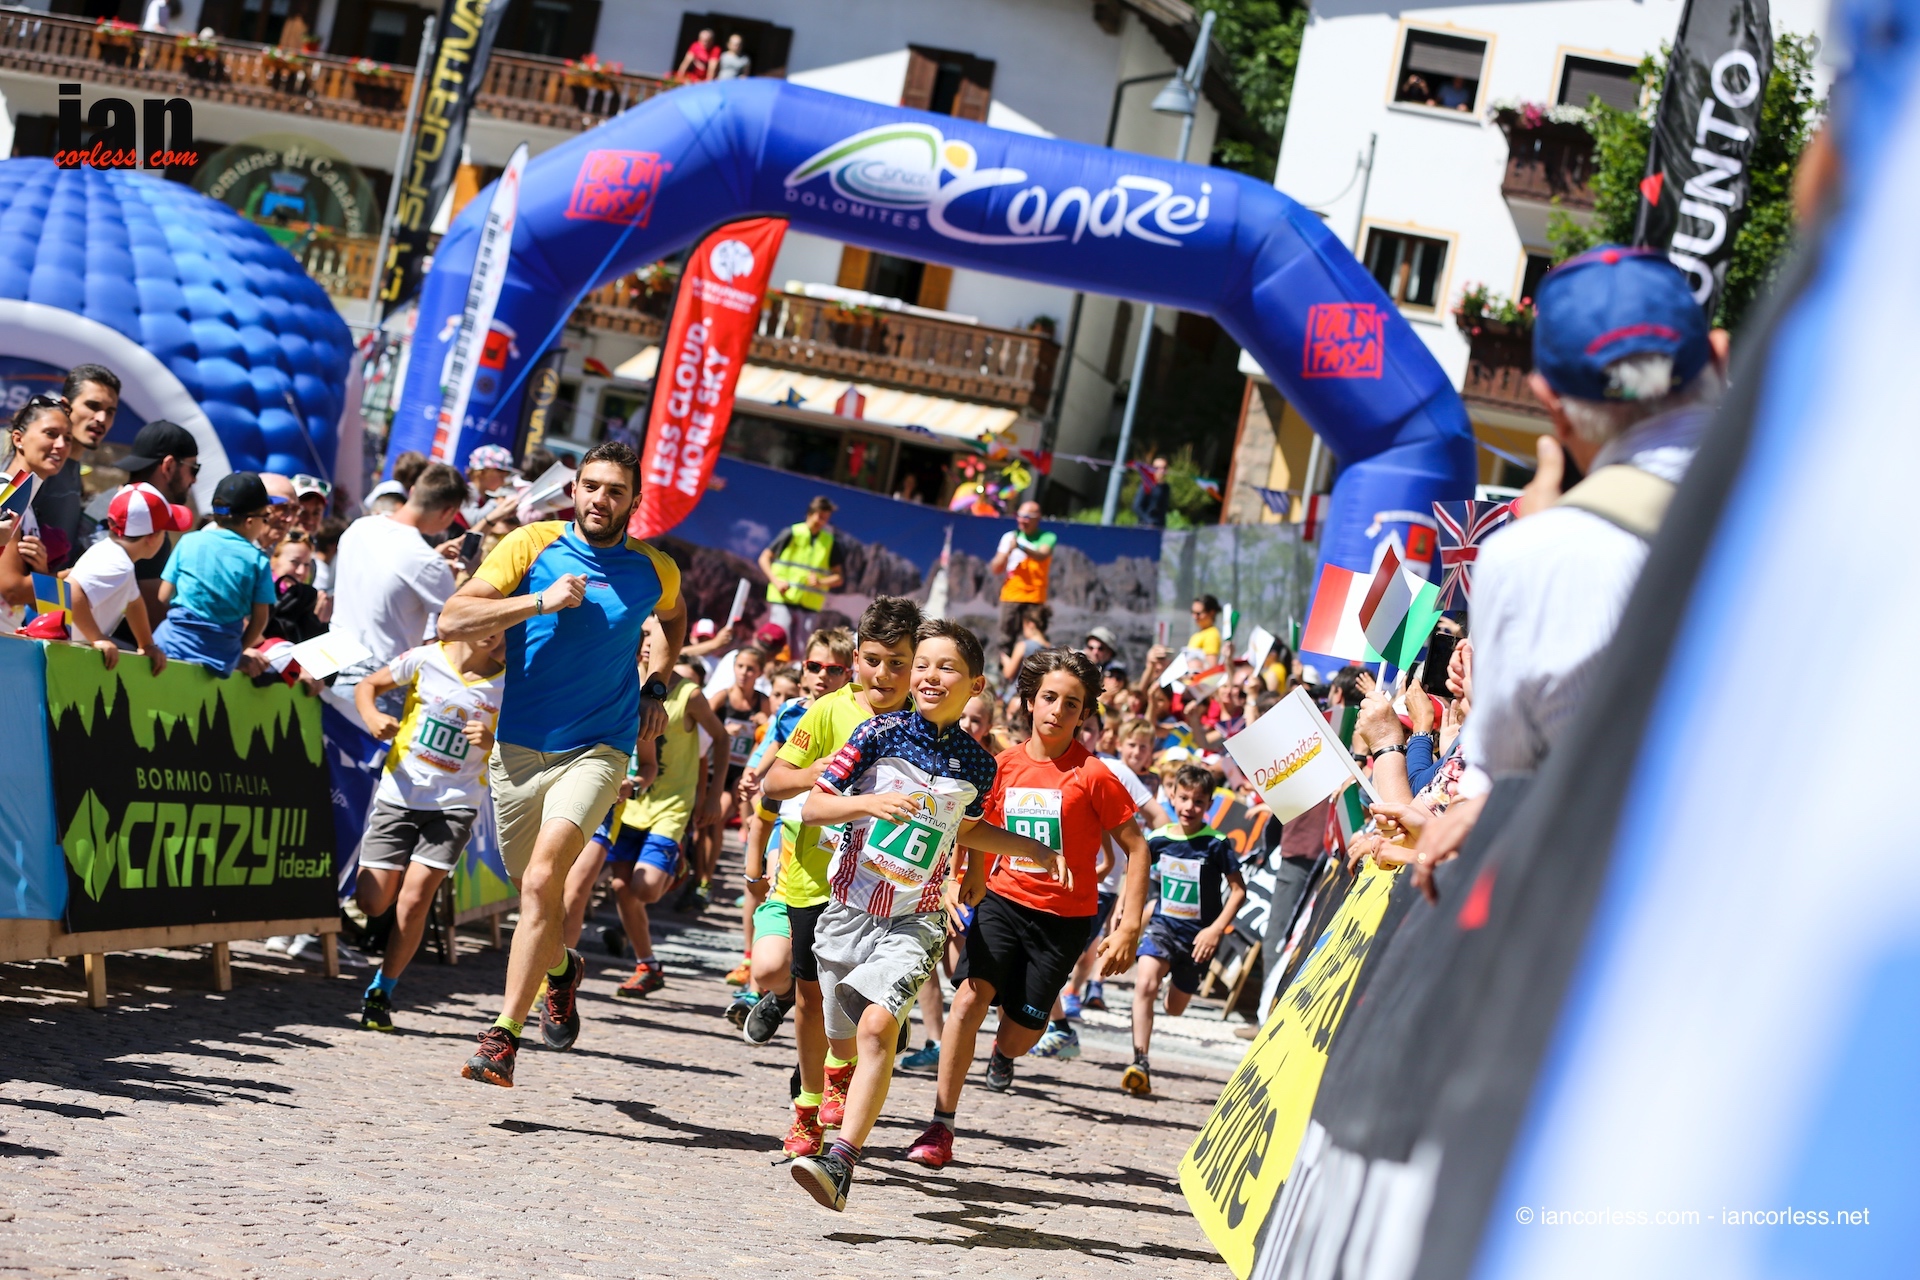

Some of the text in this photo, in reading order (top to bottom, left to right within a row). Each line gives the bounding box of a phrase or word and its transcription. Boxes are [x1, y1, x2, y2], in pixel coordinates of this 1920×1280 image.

[202, 150, 278, 199] omune
[784, 188, 921, 231] DOLOMITES
[423, 404, 508, 437] CAZEI
[647, 316, 714, 488] LESS CLOUD.
[675, 411, 715, 497] MORE
[697, 345, 731, 407] SKY
[421, 721, 467, 757] 108
[1254, 732, 1321, 786] Dolomites
[136, 767, 271, 796] BORMIO ITALIA
[1017, 808, 1059, 816] SPORTIVA
[117, 801, 281, 889] CRAZY
[878, 823, 932, 863] 76
[874, 853, 924, 882] Dolomites
[1167, 879, 1193, 902] 77
